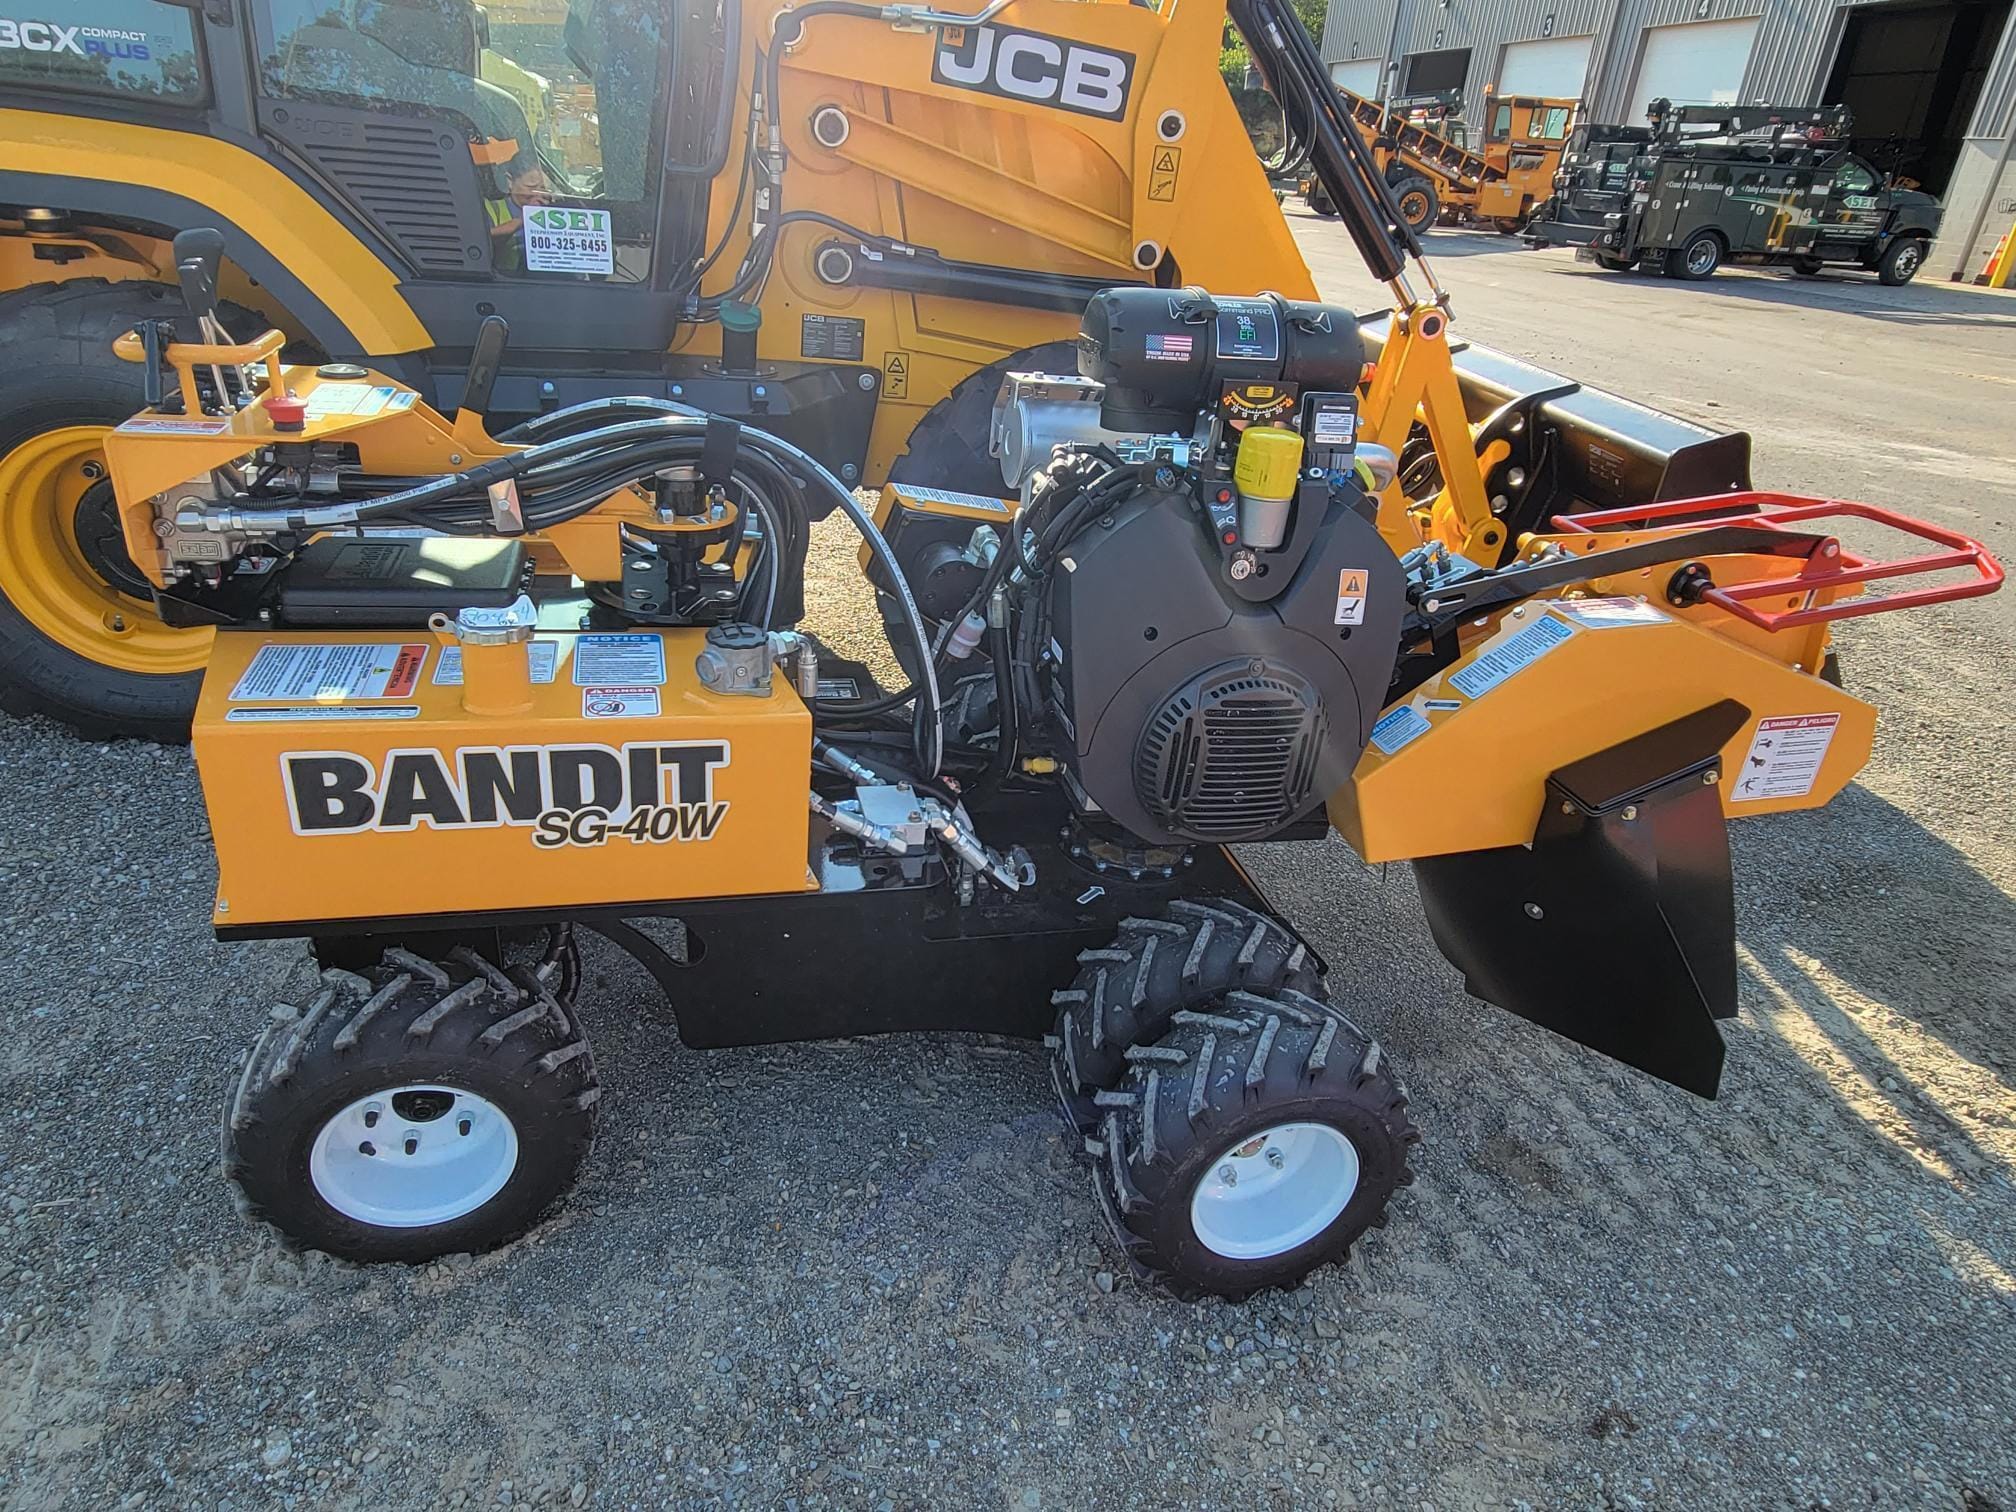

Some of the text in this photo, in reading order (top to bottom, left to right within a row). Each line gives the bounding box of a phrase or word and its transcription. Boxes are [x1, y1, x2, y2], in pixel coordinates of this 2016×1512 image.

[1697, 0, 1708, 17] 4
[81, 27, 147, 42] COMPACT
[1543, 17, 1553, 35] 3
[0, 19, 84, 55] 3CX
[1434, 33, 1443, 48] 2
[84, 39, 149, 61] PLUS
[939, 27, 1127, 113] JCB
[548, 209, 604, 231] SEI
[531, 236, 607, 253] 800-325-6455
[803, 314, 825, 322] JCB
[1236, 316, 1251, 325] 38
[1239, 329, 1256, 341] EFI
[1372, 709, 1406, 734] NOTICE
[1770, 717, 1838, 728] DANGER PELIGRO
[288, 745, 725, 830] BANDIT
[535, 803, 728, 846] SG-40W
